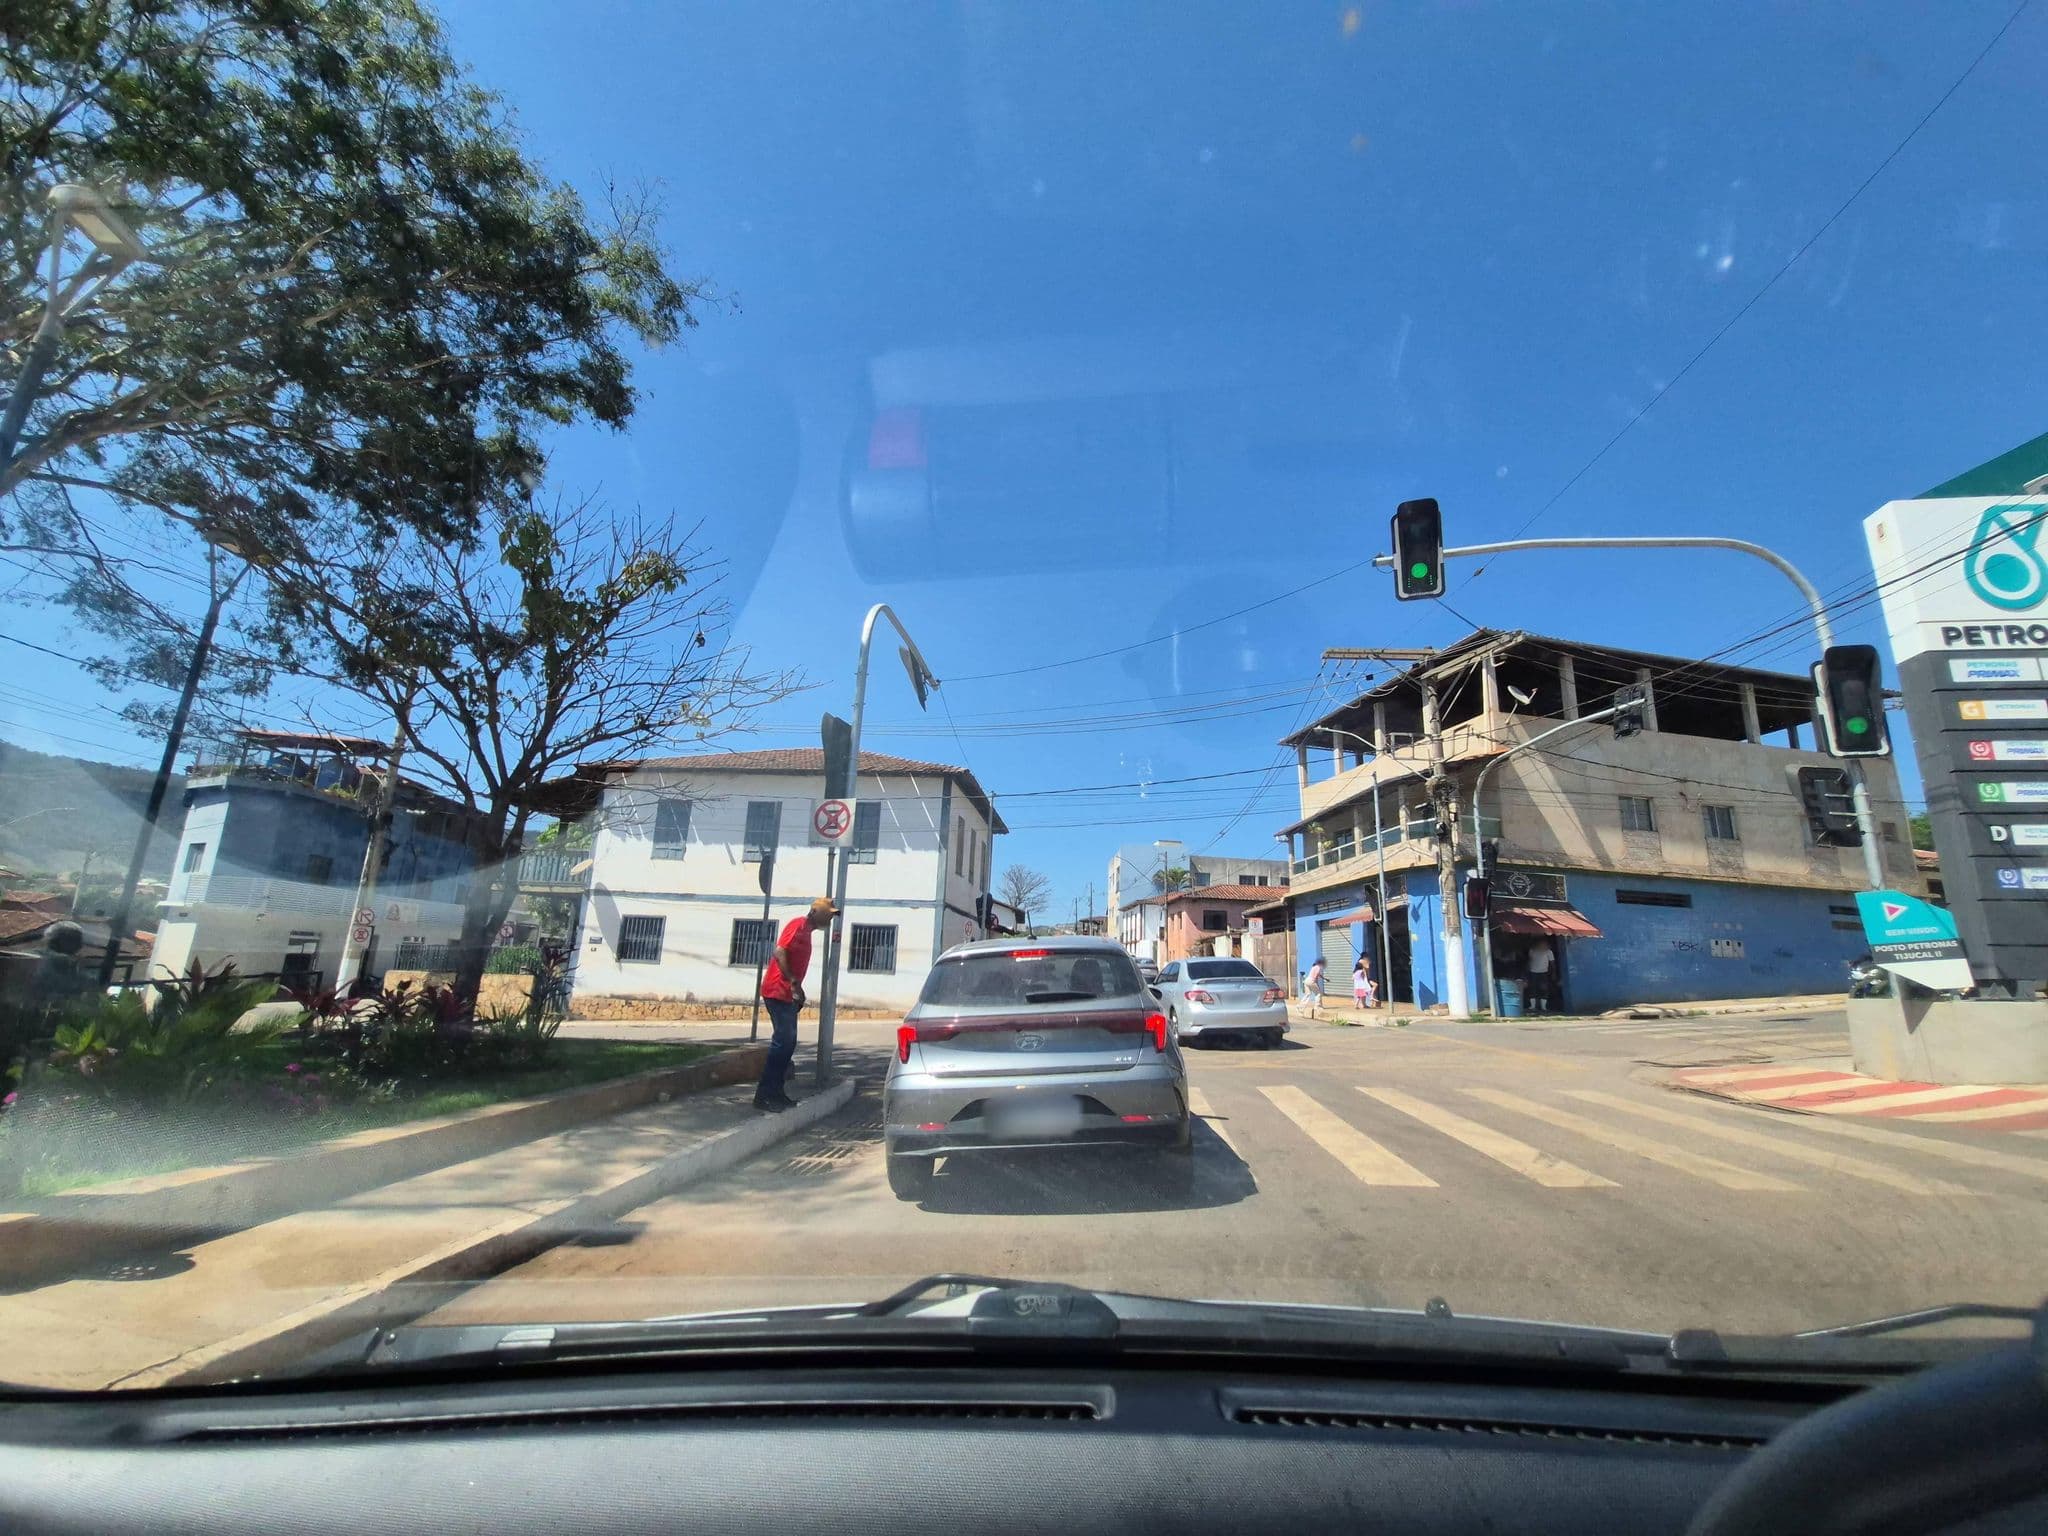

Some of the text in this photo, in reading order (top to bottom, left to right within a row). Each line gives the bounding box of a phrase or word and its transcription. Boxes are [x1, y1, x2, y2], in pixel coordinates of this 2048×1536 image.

[1990, 825, 2008, 842] D
[1874, 940, 1959, 952] POSTO PETRONAS
[1894, 952, 1934, 960] TIJUCAL
